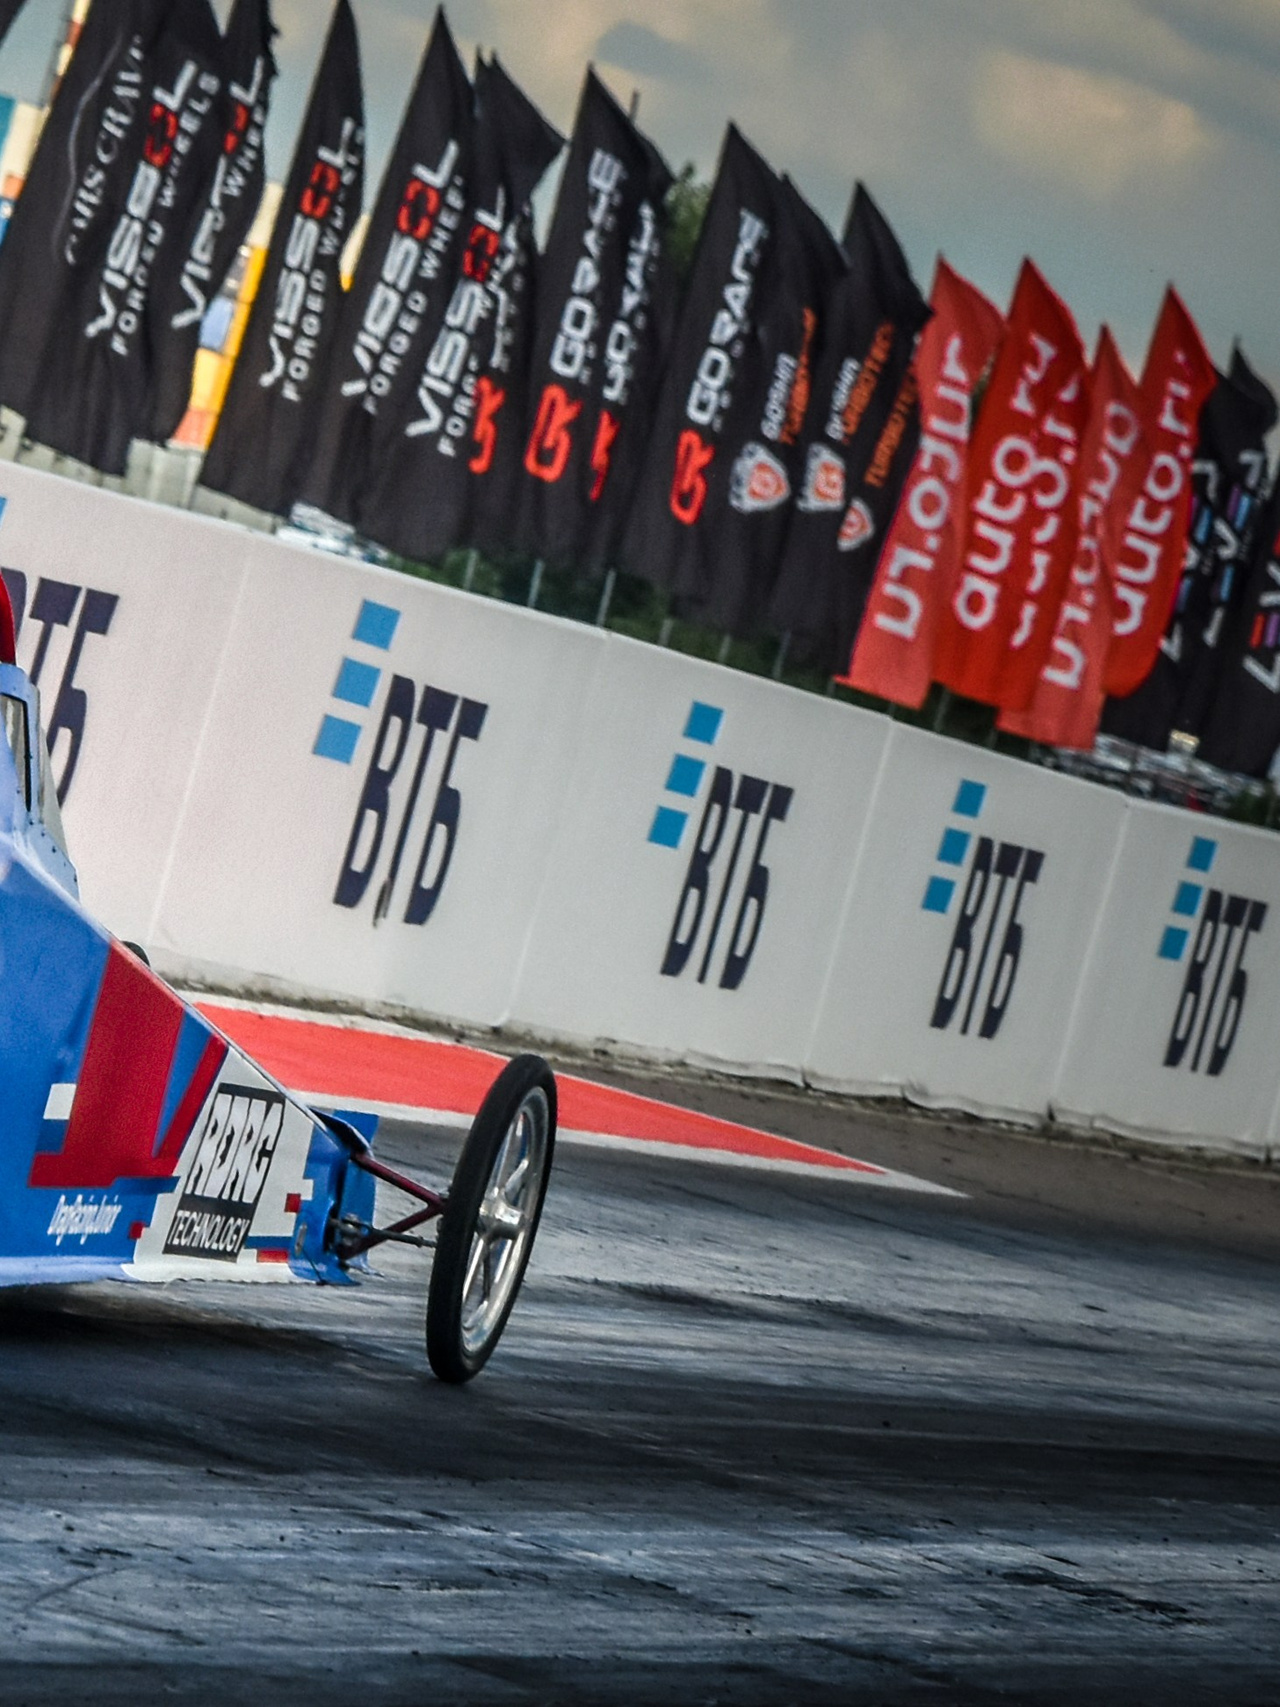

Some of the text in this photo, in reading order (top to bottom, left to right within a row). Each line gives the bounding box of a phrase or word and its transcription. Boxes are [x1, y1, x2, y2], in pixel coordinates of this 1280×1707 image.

[259, 116, 356, 389] VISSOL
[341, 139, 460, 399] VISSOL
[364, 290, 429, 417] FORGED
[405, 185, 506, 438] VISSOL
[332, 674, 489, 926] ВТБ
[660, 766, 795, 991] ВТБ
[930, 836, 1046, 1040] ВТБ
[1163, 889, 1269, 1078] ВТБ
[167, 1209, 251, 1254] TECHNOLOGY
